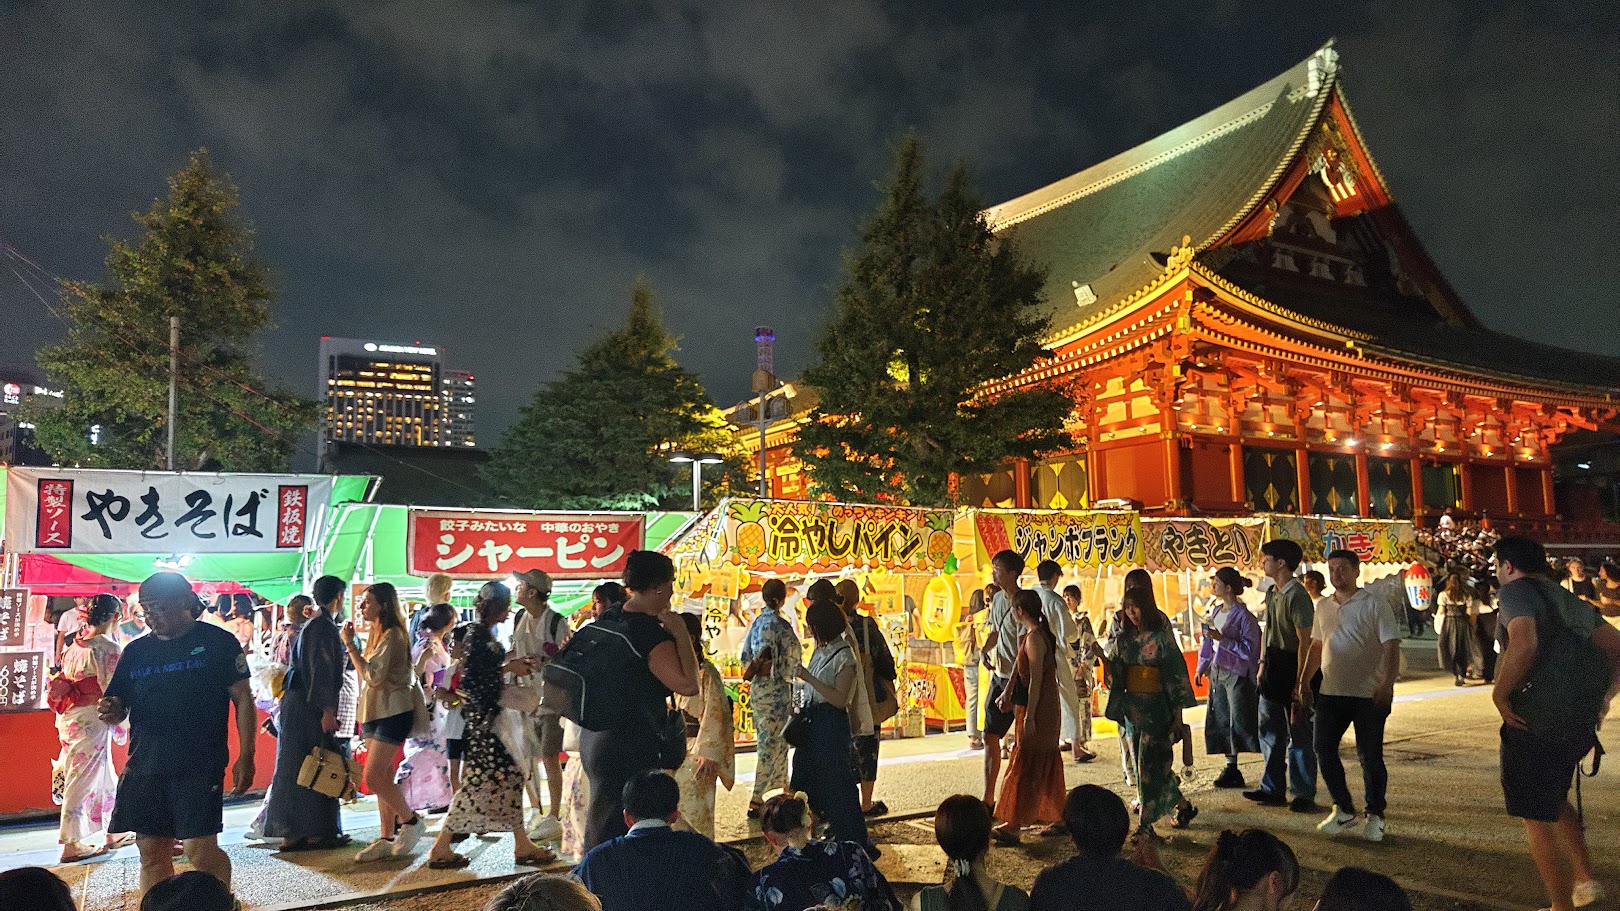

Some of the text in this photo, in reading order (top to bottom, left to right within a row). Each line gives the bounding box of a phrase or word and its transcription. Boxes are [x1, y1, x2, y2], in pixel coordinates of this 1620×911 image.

[42, 483, 68, 546] 特製ソース
[81, 485, 271, 540] やきそば
[281, 489, 303, 545] 鉄板焼
[440, 519, 620, 534] 餃子みたいな 中華のおやき
[436, 534, 624, 571] シャーピン
[768, 514, 923, 564] 冷やしパイン
[1015, 525, 1138, 563] ジャンボフランク
[1161, 523, 1253, 568] やきとり
[1321, 530, 1399, 563] かき氷
